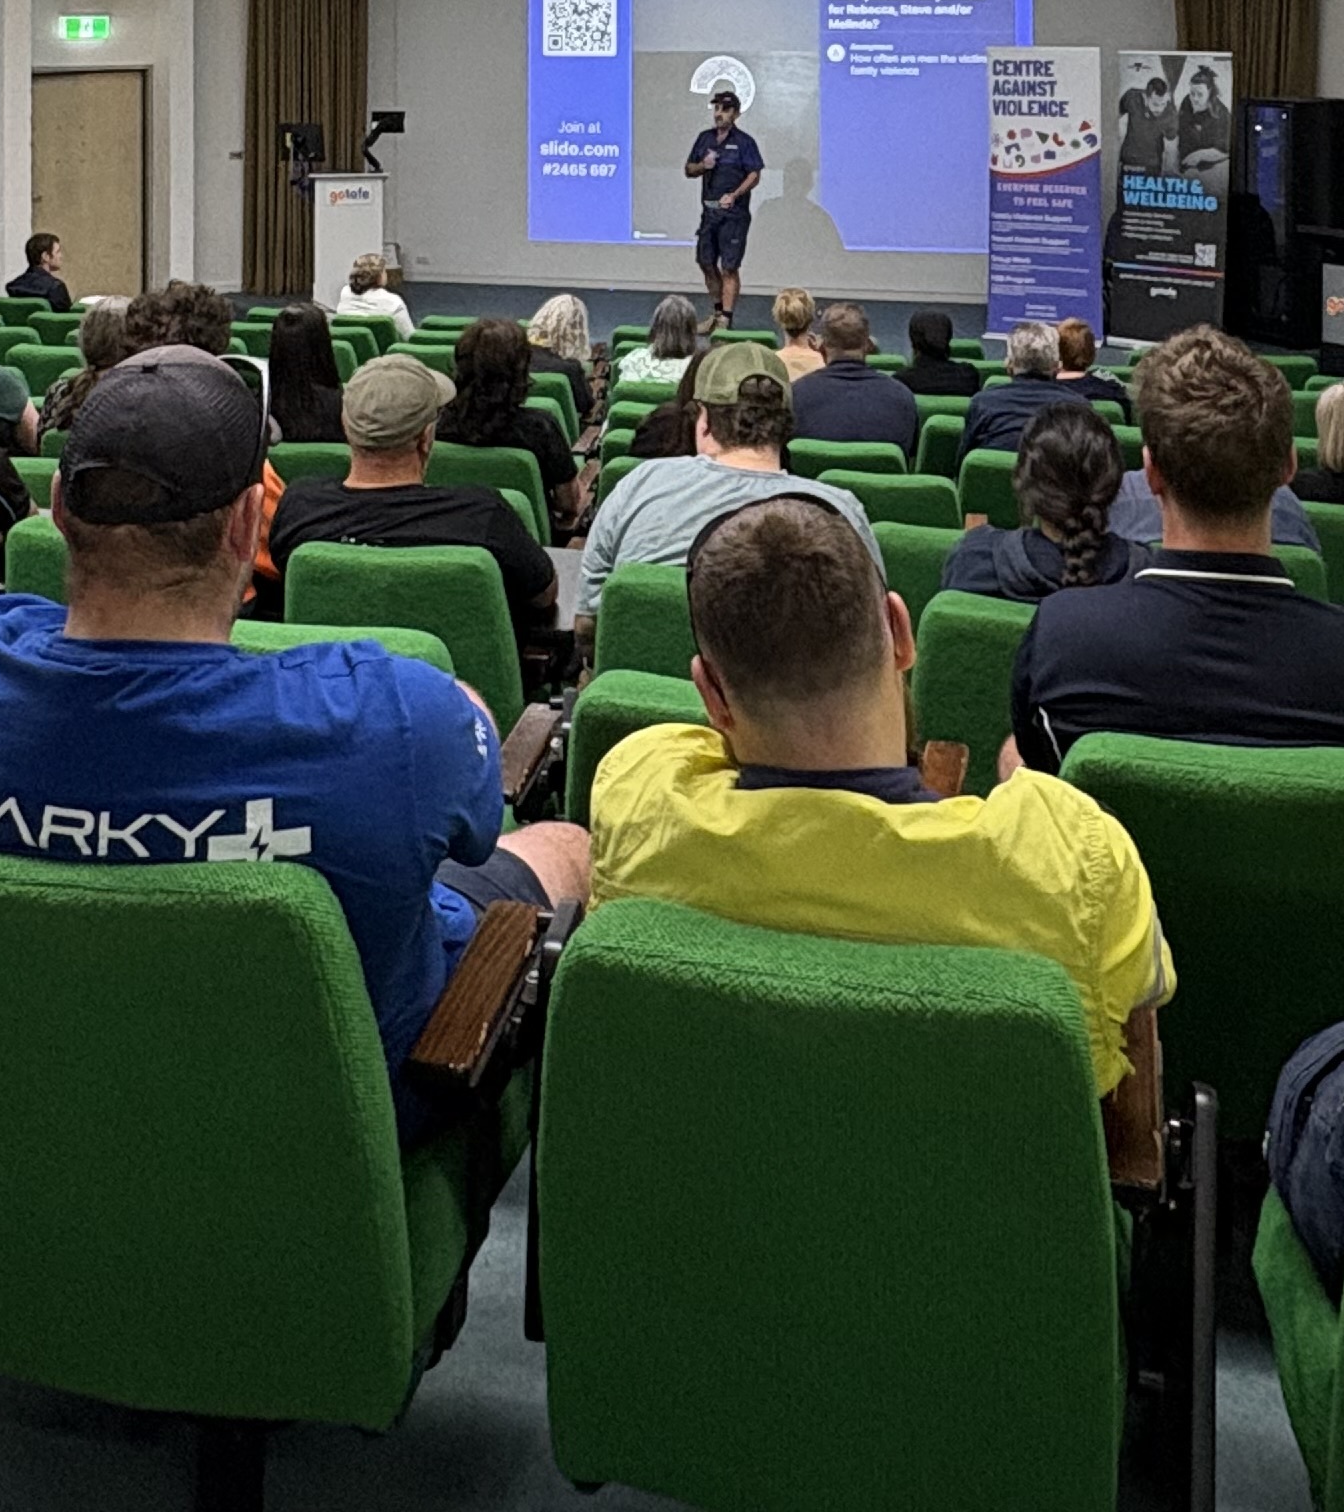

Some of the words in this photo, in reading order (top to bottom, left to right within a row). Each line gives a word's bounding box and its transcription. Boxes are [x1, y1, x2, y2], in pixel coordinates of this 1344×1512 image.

[828, 4, 845, 15] for
[934, 4, 973, 16] and/or
[850, 54, 872, 63] How
[873, 53, 899, 63] often
[850, 66, 878, 77] family
[879, 67, 919, 76] violence
[992, 59, 1054, 77] CENTRE
[992, 79, 1057, 97] AGAINST
[992, 99, 1069, 118] VIOLENCE
[558, 120, 584, 134] Join
[587, 121, 602, 134] at
[540, 140, 620, 158] slido.com
[542, 163, 587, 176] #2465
[997, 182, 1040, 193] EVERYONE
[1123, 174, 1188, 193] HEALTH
[1191, 179, 1204, 194] &
[329, 187, 370, 205] gotafe
[1027, 197, 1049, 207] FEEL
[1051, 198, 1073, 208] SAFE
[1123, 190, 1218, 211] WELLBEING
